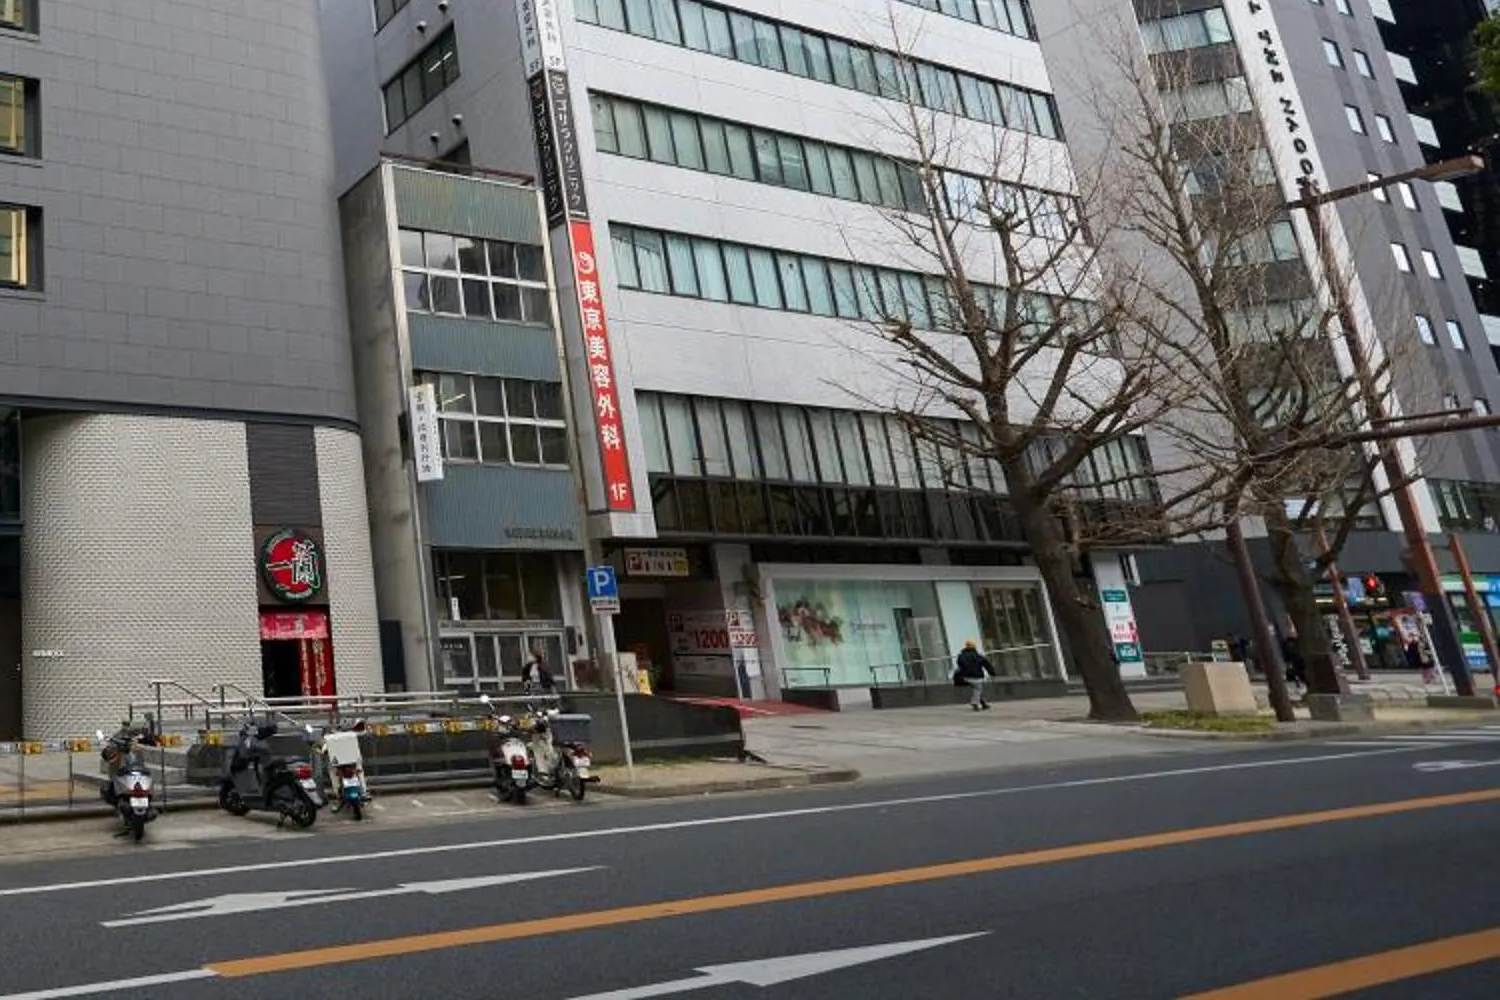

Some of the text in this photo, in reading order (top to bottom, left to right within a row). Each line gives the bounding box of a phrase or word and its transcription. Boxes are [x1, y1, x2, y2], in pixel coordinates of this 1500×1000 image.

[578, 280, 622, 451] 東京美容外科
[610, 482, 629, 503] 1F
[594, 570, 610, 595] P
